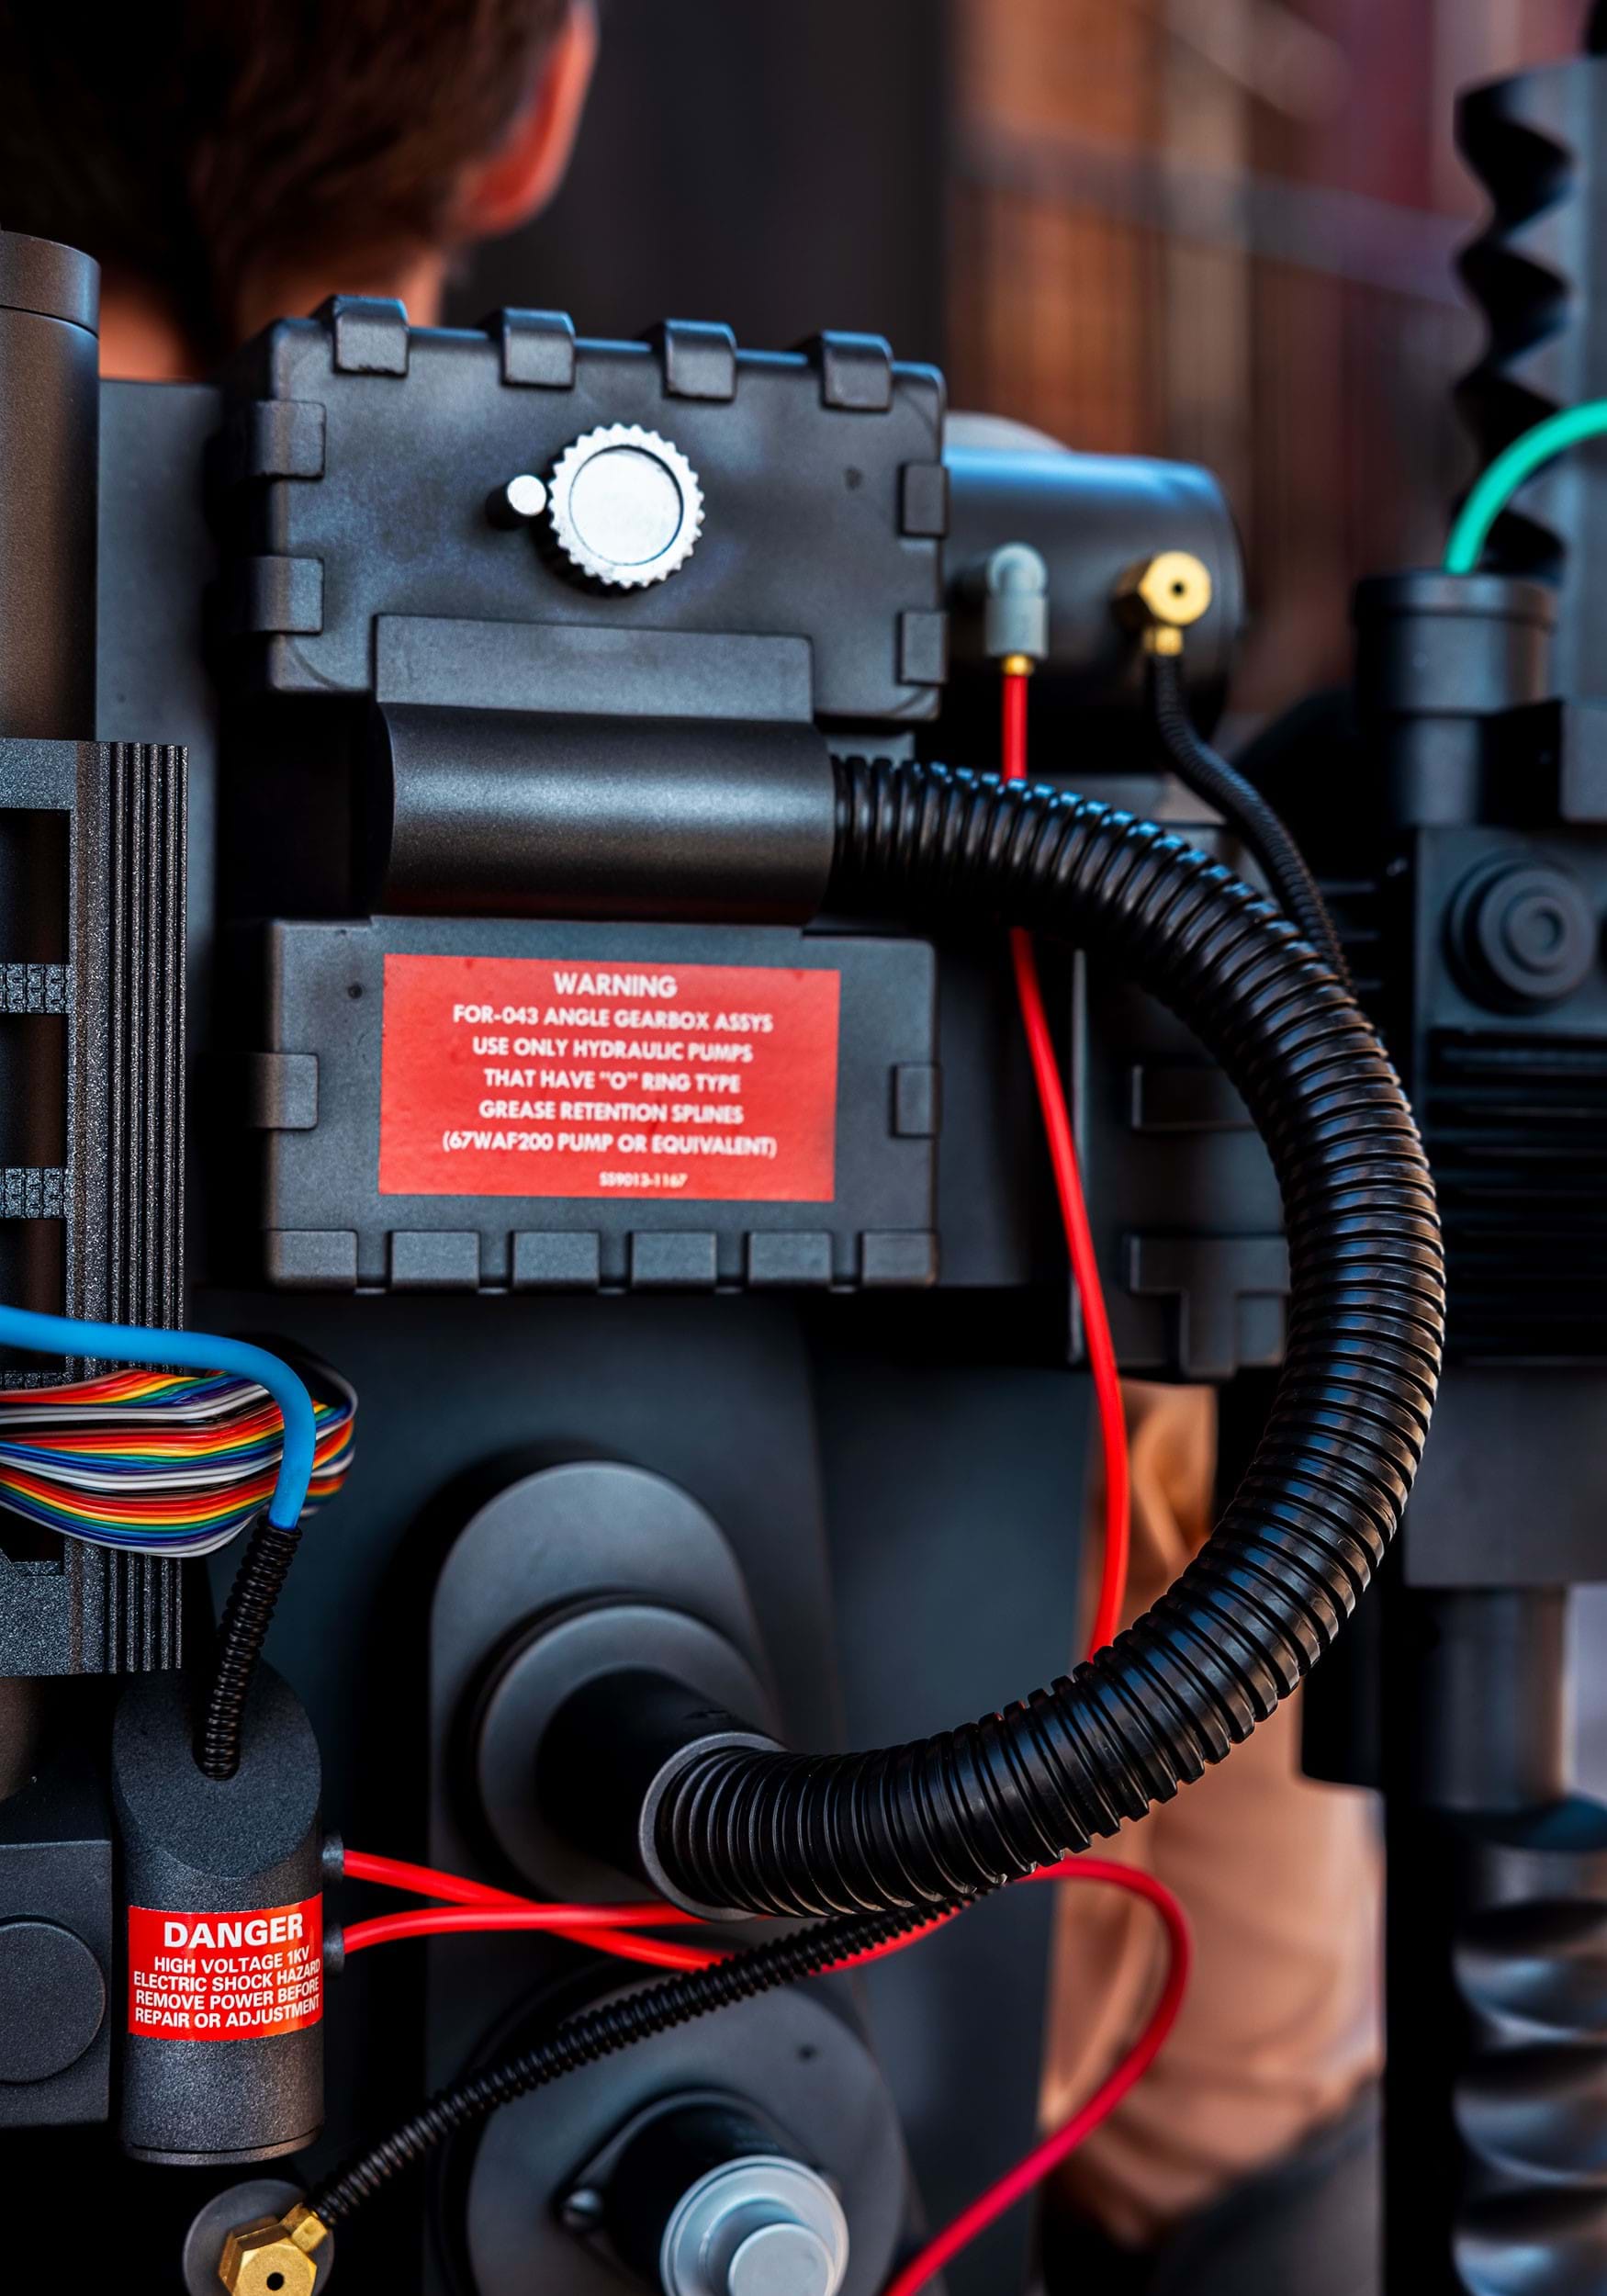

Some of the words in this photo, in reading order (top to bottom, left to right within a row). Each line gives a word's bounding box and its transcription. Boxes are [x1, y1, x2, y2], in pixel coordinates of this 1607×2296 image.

[554, 973, 677, 998] WARNING
[453, 1004, 539, 1025] FOR-043
[544, 1007, 611, 1028] ANGLE
[613, 1009, 710, 1030] GEARBOX
[714, 1013, 773, 1032] ASSYS
[472, 1037, 509, 1055] USE
[513, 1038, 568, 1057] ONLY
[573, 1039, 684, 1061] HYDRAULIC
[689, 1043, 753, 1063] PUMPS
[484, 1068, 536, 1087] THAT
[540, 1070, 595, 1089] HAVE
[600, 1071, 638, 1090] "O"
[642, 1073, 691, 1091] RING
[695, 1074, 741, 1093] TYPE
[478, 1099, 556, 1120] GREASE
[560, 1101, 668, 1122] RETENTION
[672, 1104, 745, 1124] SPLINES
[443, 1131, 555, 1152] (67WAF200
[558, 1133, 613, 1152] PUMP
[618, 1133, 647, 1153] OR
[651, 1135, 778, 1159] EQUIVALENT)
[163, 1913, 303, 1948] DANGER
[154, 1956, 196, 1974] HIGH
[201, 1952, 283, 1974] VOLTAGE
[287, 1945, 309, 1964] 1KV
[133, 1971, 208, 1992] ELECTRIC
[212, 1972, 274, 1992] SHOCK
[276, 1958, 320, 1986] HAZARD
[136, 1989, 205, 2009] REMOVE
[209, 1990, 275, 2009] POWER
[277, 1975, 320, 2004] BEFORE
[135, 2008, 189, 2028] REPAIR
[194, 2012, 221, 2028] OR
[225, 1994, 320, 2026] ADJUSTMENT
